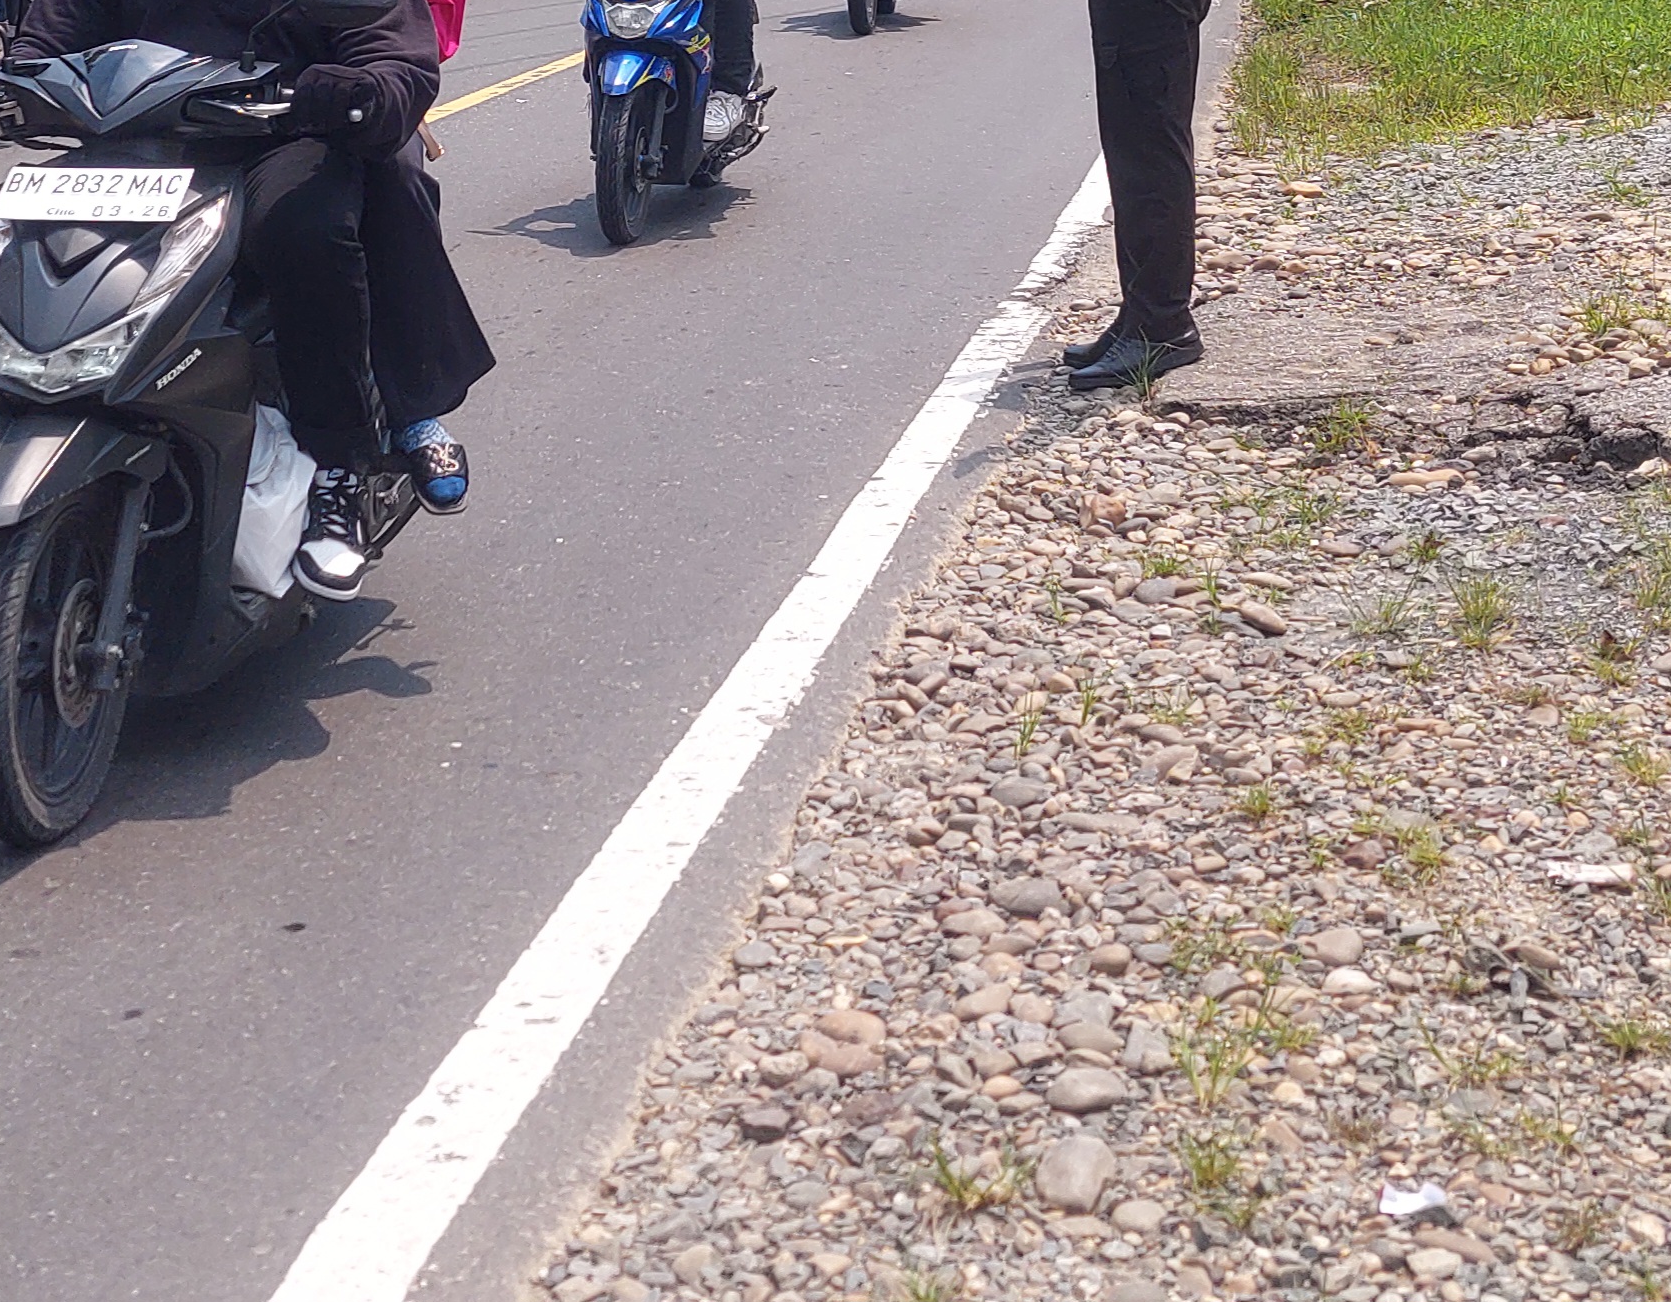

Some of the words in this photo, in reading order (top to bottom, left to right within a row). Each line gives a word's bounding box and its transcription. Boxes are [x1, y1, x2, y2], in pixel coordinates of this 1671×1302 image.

[6, 172, 47, 194] BM
[52, 173, 124, 195] 2832
[126, 174, 183, 196] MAC
[155, 347, 203, 391] HONDA
